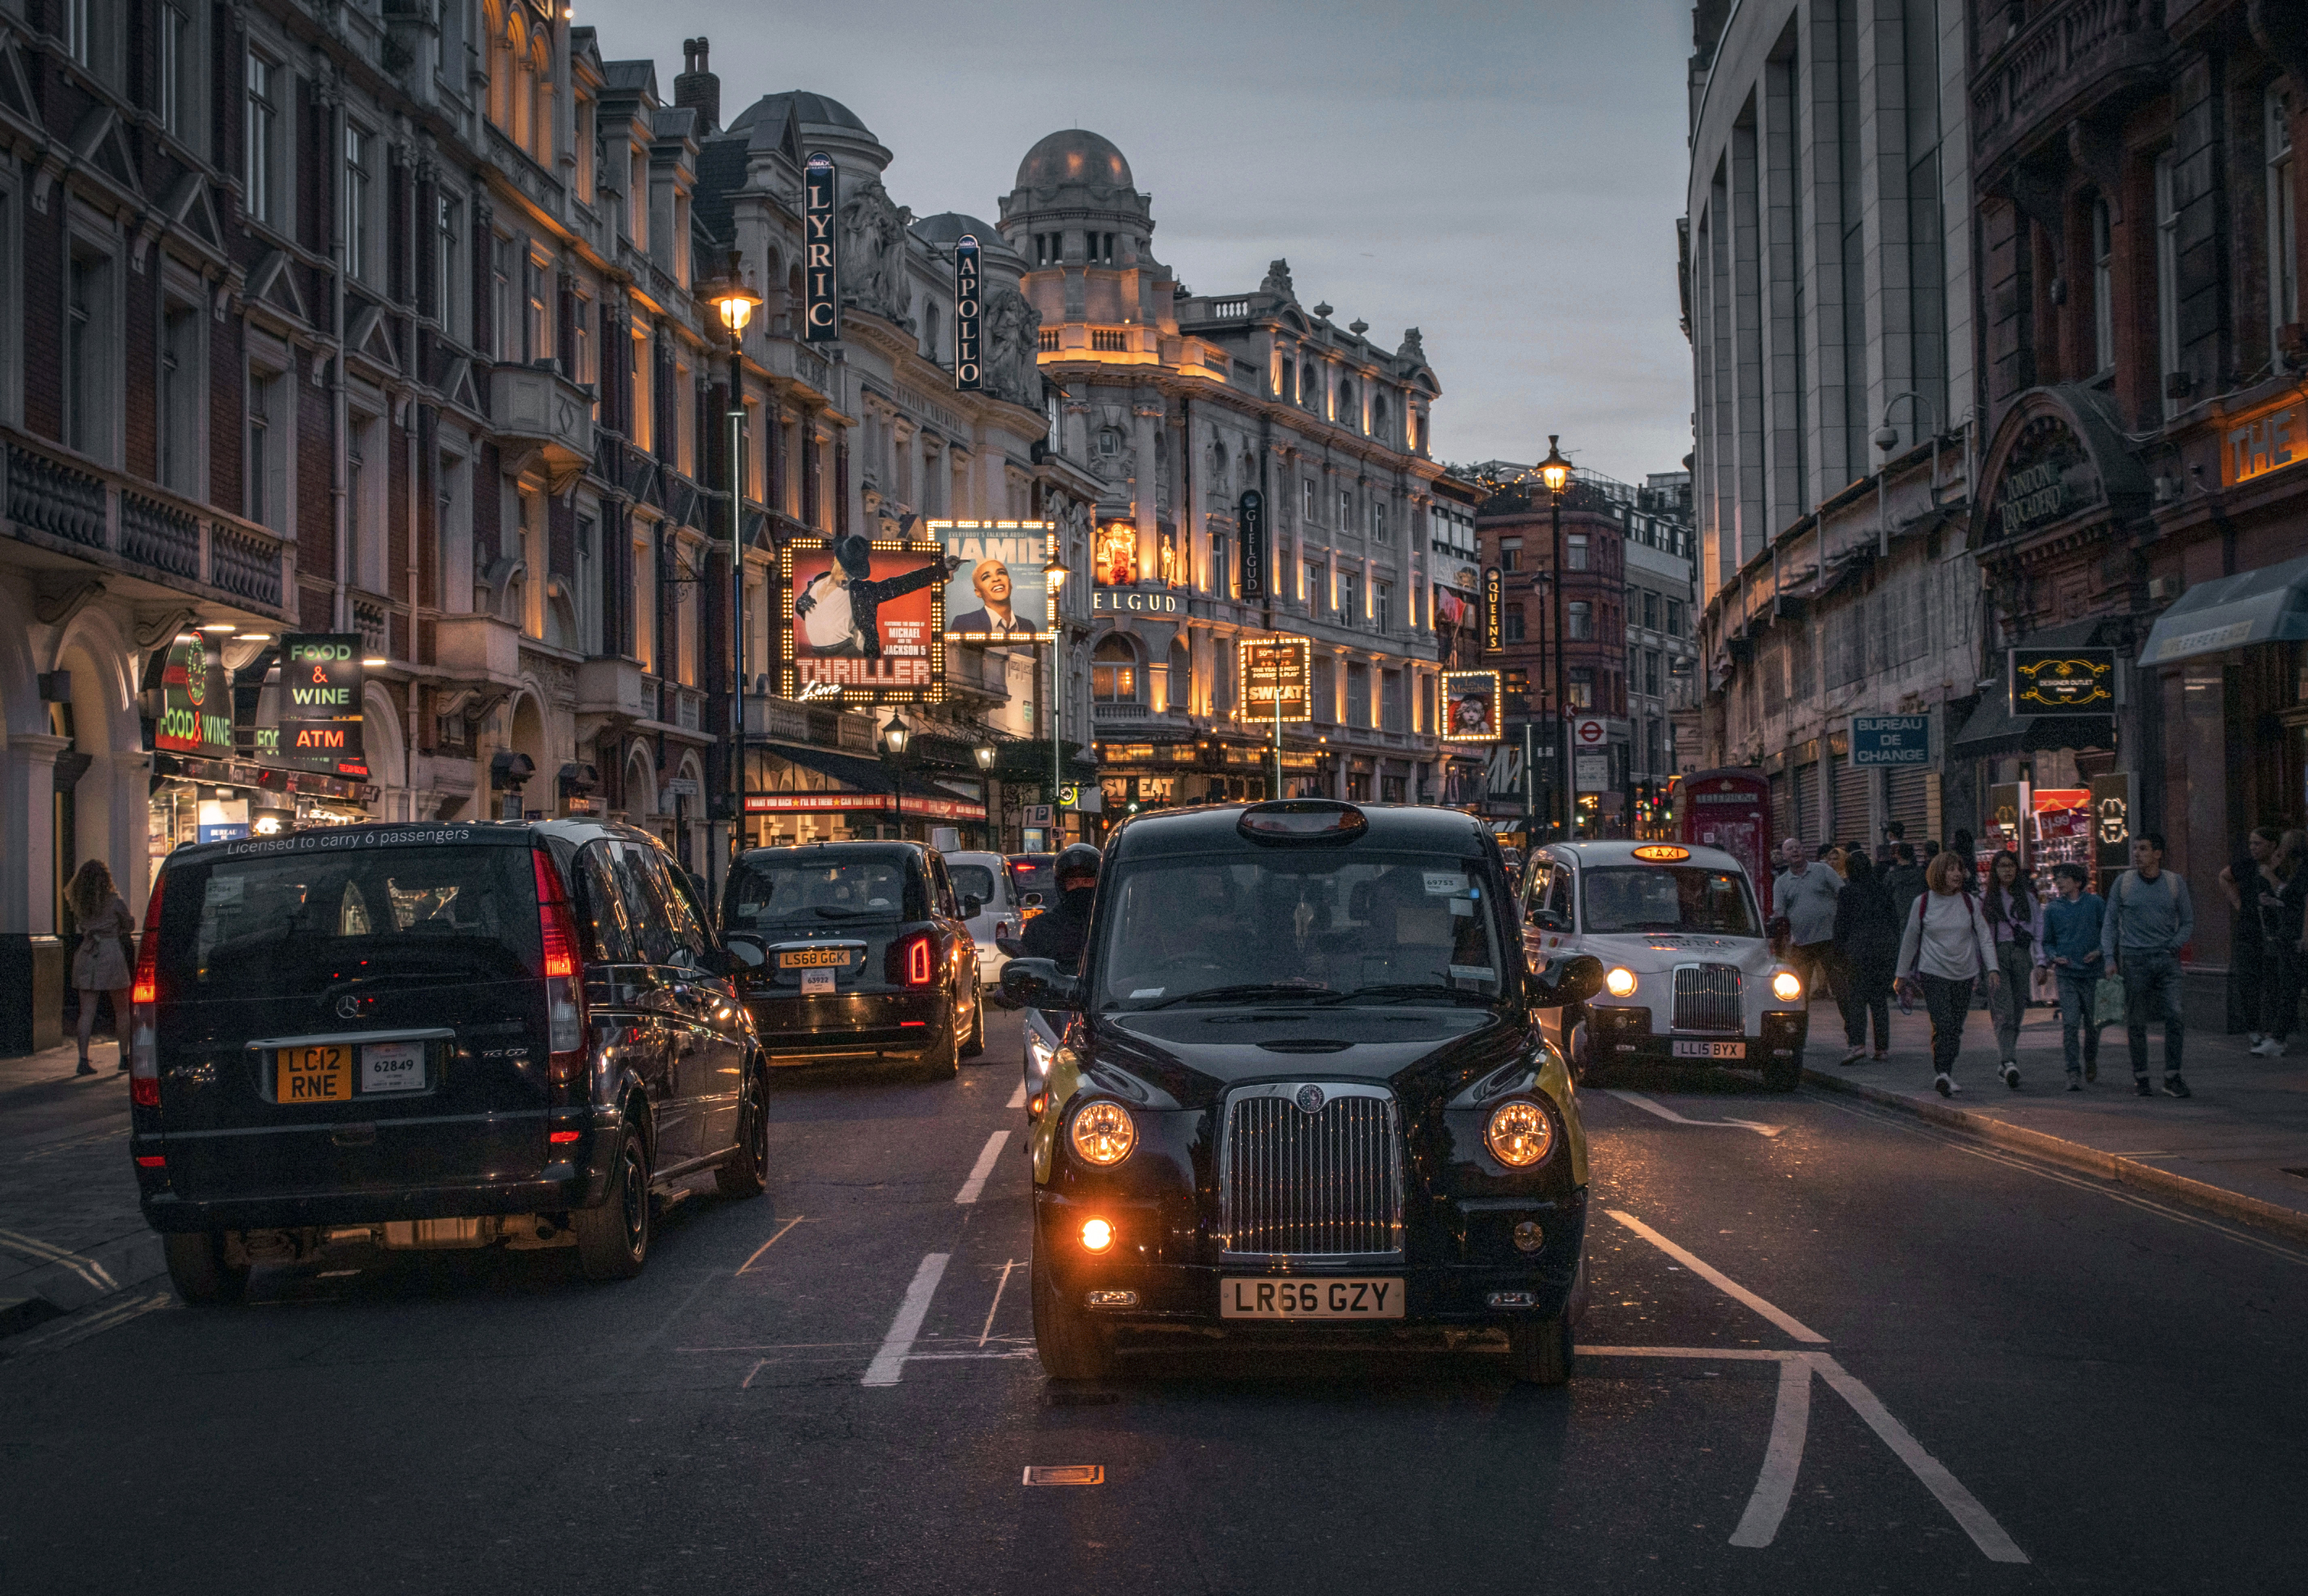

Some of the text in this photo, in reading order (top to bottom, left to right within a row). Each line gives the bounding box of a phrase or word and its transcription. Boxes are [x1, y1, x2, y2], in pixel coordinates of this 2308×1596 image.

[808, 186, 833, 326] LYRIC
[959, 258, 979, 381] APOLLO
[944, 538, 1045, 564] JAMIE
[1246, 510, 1259, 590] GIELGUD
[1489, 582, 1499, 647] QUEENS
[889, 628, 920, 638] MICHAEL
[291, 644, 351, 661] FOOD
[884, 645, 926, 655] JACKSON 5
[312, 666, 328, 683] &
[796, 659, 930, 685] THRILLER
[292, 688, 350, 704] WINE
[798, 680, 841, 701] Live
[1248, 685, 1304, 700] SWEAT
[1566, 705, 1575, 716] K
[1858, 719, 1922, 731] BUREAU
[296, 730, 344, 747] ATM
[1880, 734, 1901, 746] DE
[1858, 750, 1925, 762] CHANGE
[1038, 808, 1047, 819] P
[227, 828, 469, 854] Licensed to carry 6 passengers
[1647, 849, 1679, 857] TAXI
[785, 952, 845, 965] LS68 GGK
[1681, 1043, 1737, 1056] LL15 BYX
[288, 1049, 340, 1072] LC12
[374, 1059, 413, 1072] 62849
[292, 1074, 337, 1098] RNE
[1236, 1282, 1390, 1312] LR66 GZY
